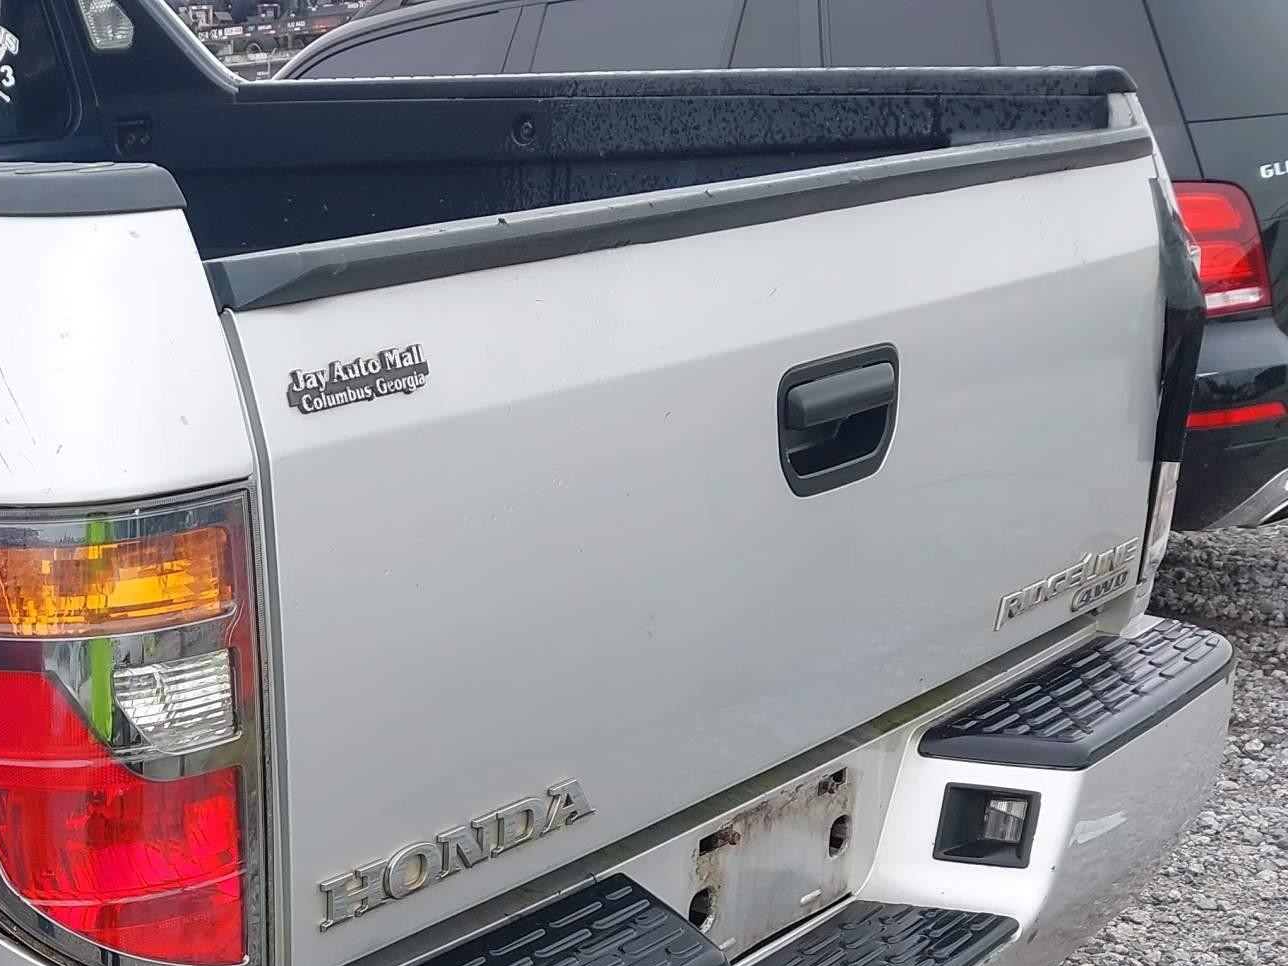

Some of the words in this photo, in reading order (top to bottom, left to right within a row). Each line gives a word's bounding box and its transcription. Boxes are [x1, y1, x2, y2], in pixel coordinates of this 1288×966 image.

[291, 369, 328, 394] Jay
[331, 358, 381, 383] Auto
[382, 344, 426, 371] Mall
[376, 371, 426, 396] Georgia
[993, 536, 1138, 631] RIDGELINE
[1076, 569, 1129, 606] 4WD
[319, 778, 597, 932] HONDA
